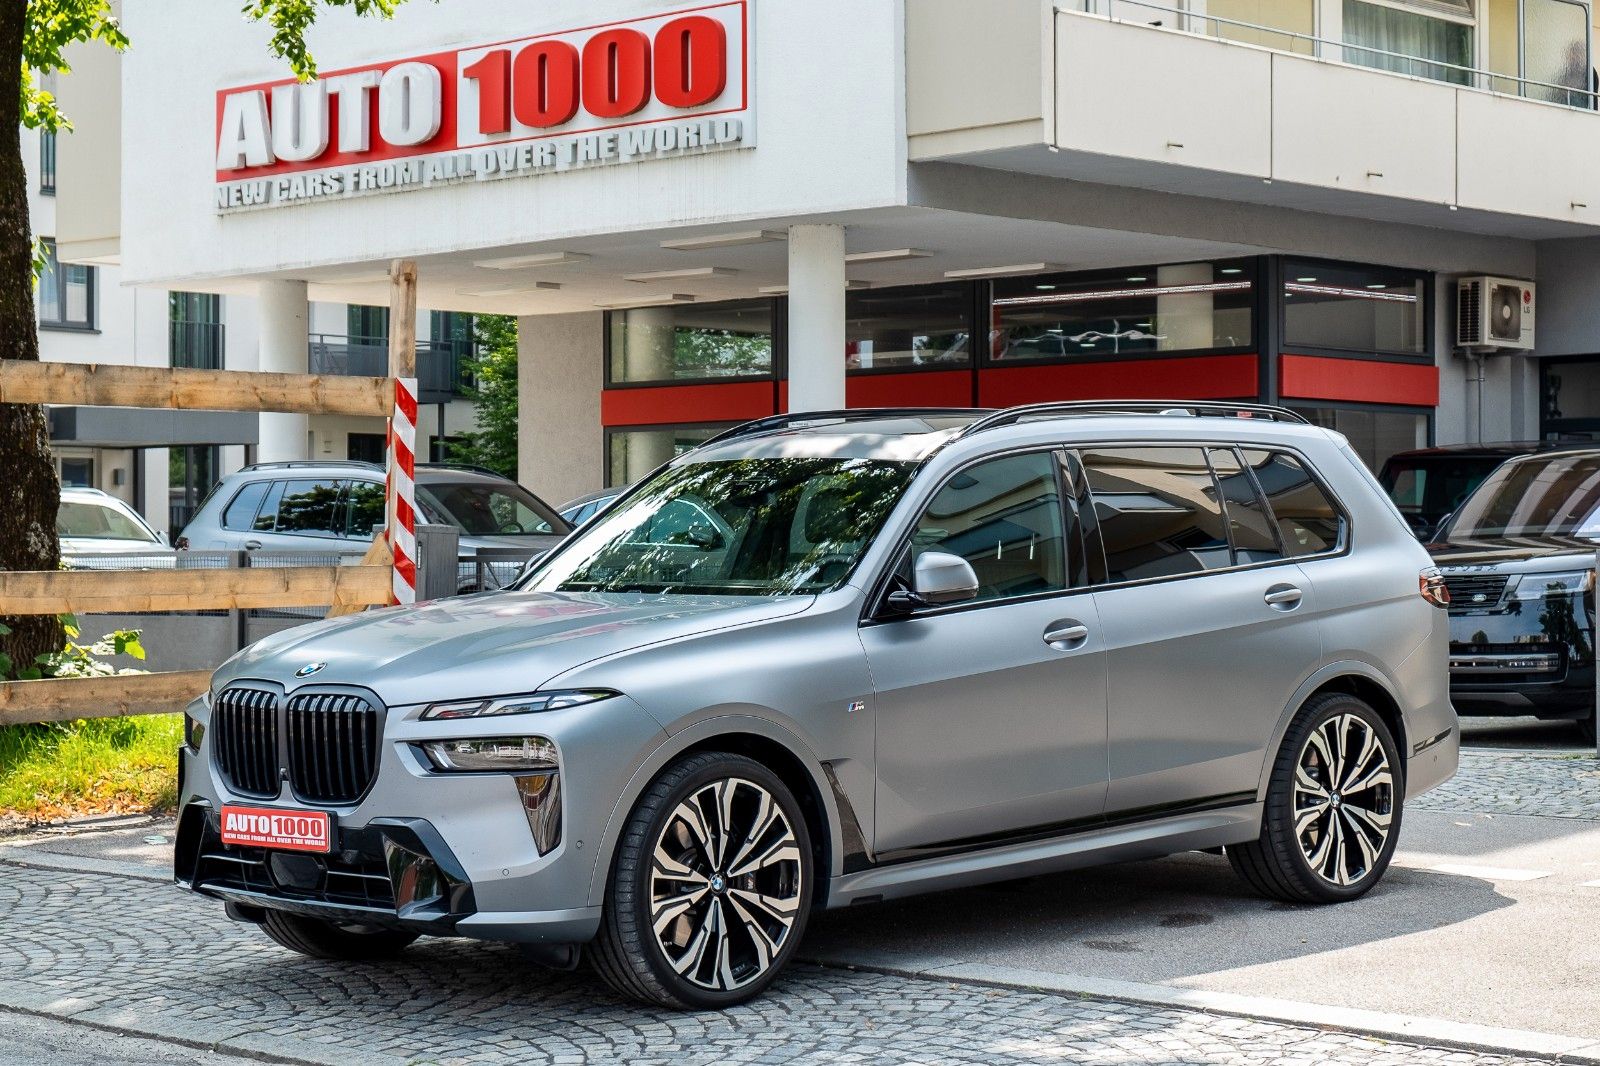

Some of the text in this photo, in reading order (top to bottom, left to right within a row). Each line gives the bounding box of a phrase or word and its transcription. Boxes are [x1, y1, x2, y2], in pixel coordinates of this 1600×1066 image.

[216, 15, 727, 170] AUTO 1000
[217, 119, 743, 209] NEW CARS FROM ALL OVER THE WORLD
[1523, 306, 1531, 314] LG
[225, 813, 323, 838] AUTO 1000
